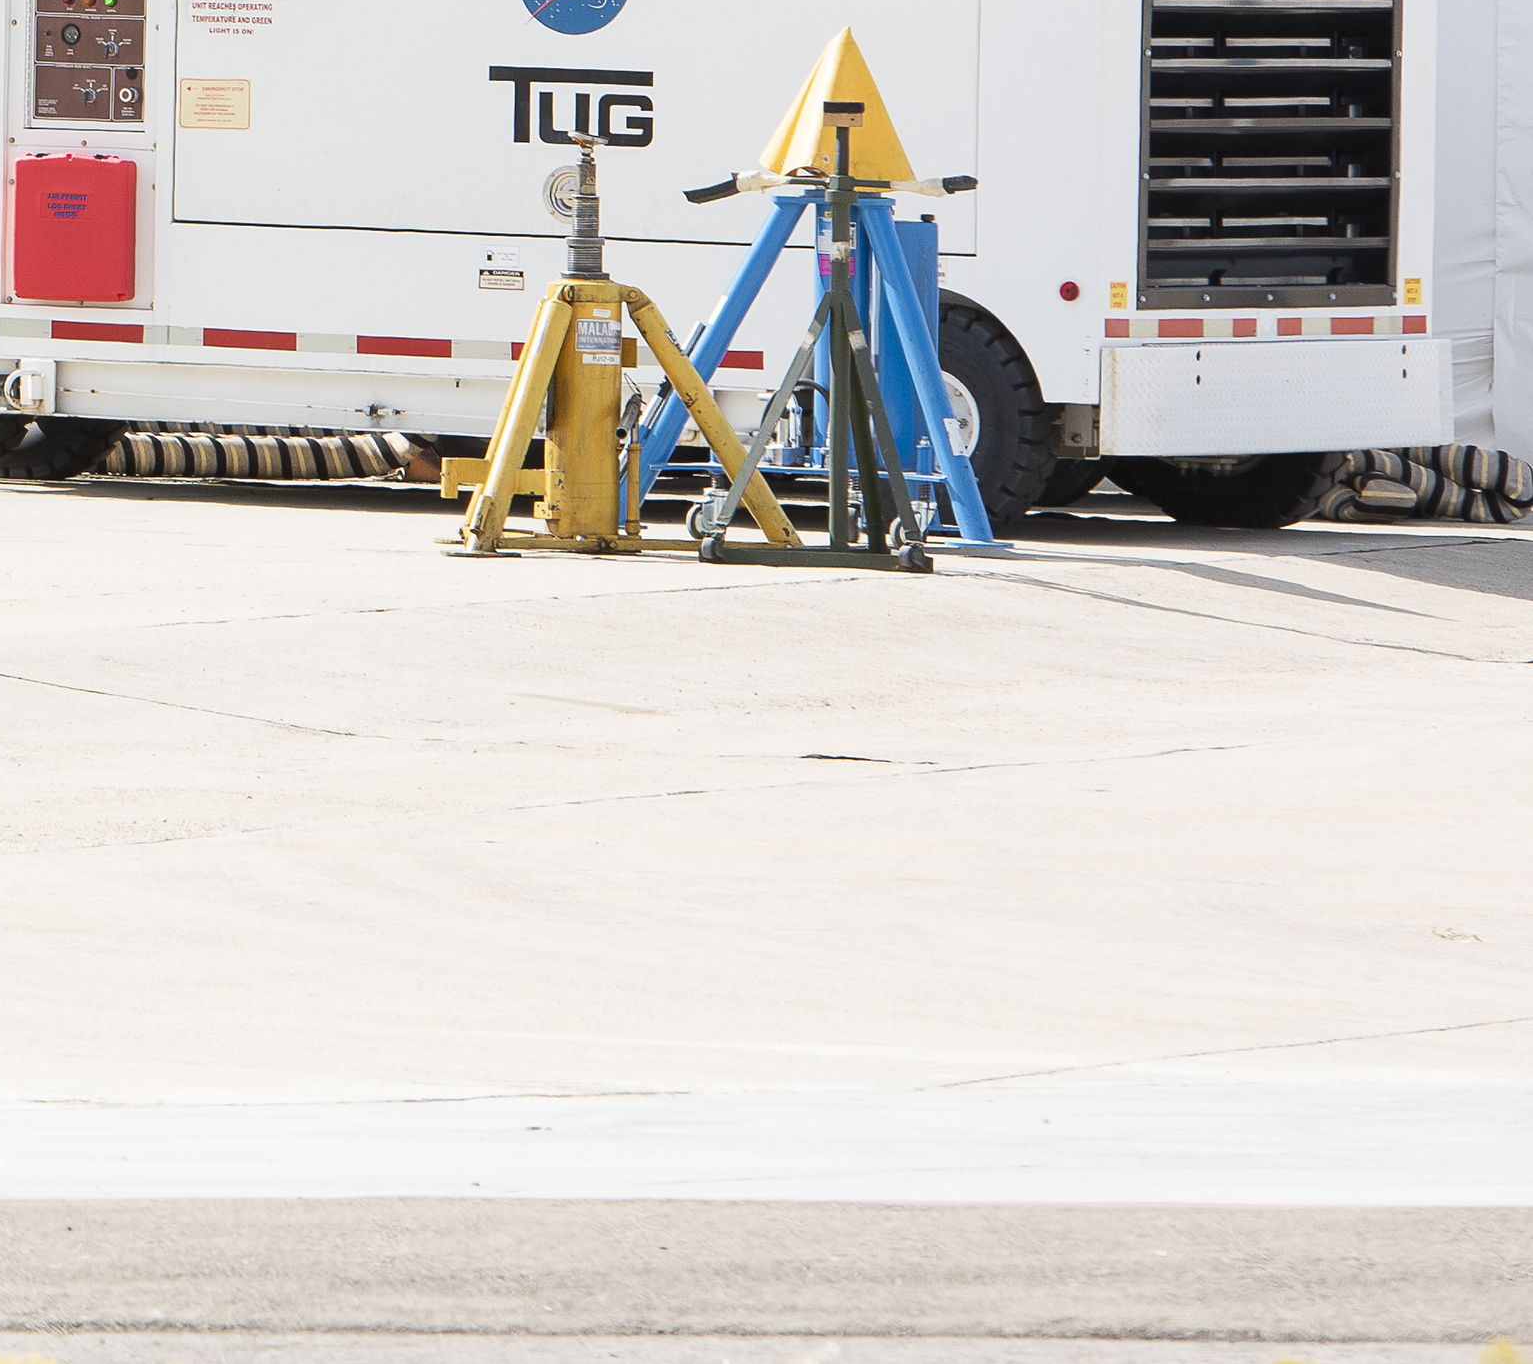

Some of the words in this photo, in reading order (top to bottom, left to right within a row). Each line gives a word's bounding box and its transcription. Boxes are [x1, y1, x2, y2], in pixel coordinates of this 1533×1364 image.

[208, 2, 236, 10] REACHES
[238, 3, 273, 11] OPERATING
[192, 15, 236, 23] TEMPERATURE
[252, 16, 272, 24] GREEN
[488, 65, 654, 148] TUG
